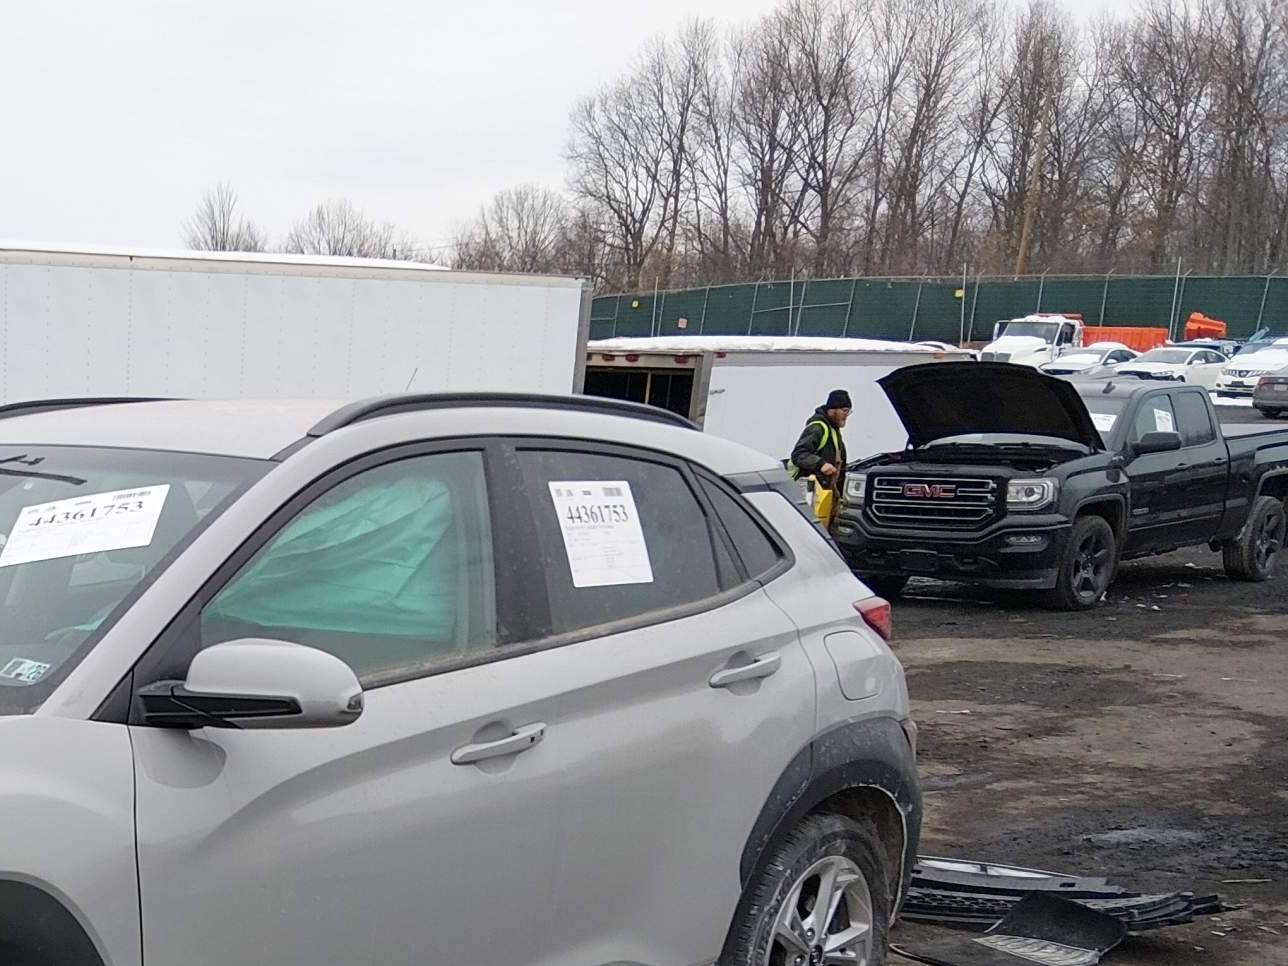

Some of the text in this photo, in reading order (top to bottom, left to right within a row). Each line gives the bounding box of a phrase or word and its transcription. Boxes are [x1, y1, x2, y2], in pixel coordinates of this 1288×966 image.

[903, 483, 957, 498] GMC
[28, 501, 143, 526] 44361753
[567, 503, 629, 524] 44361753
